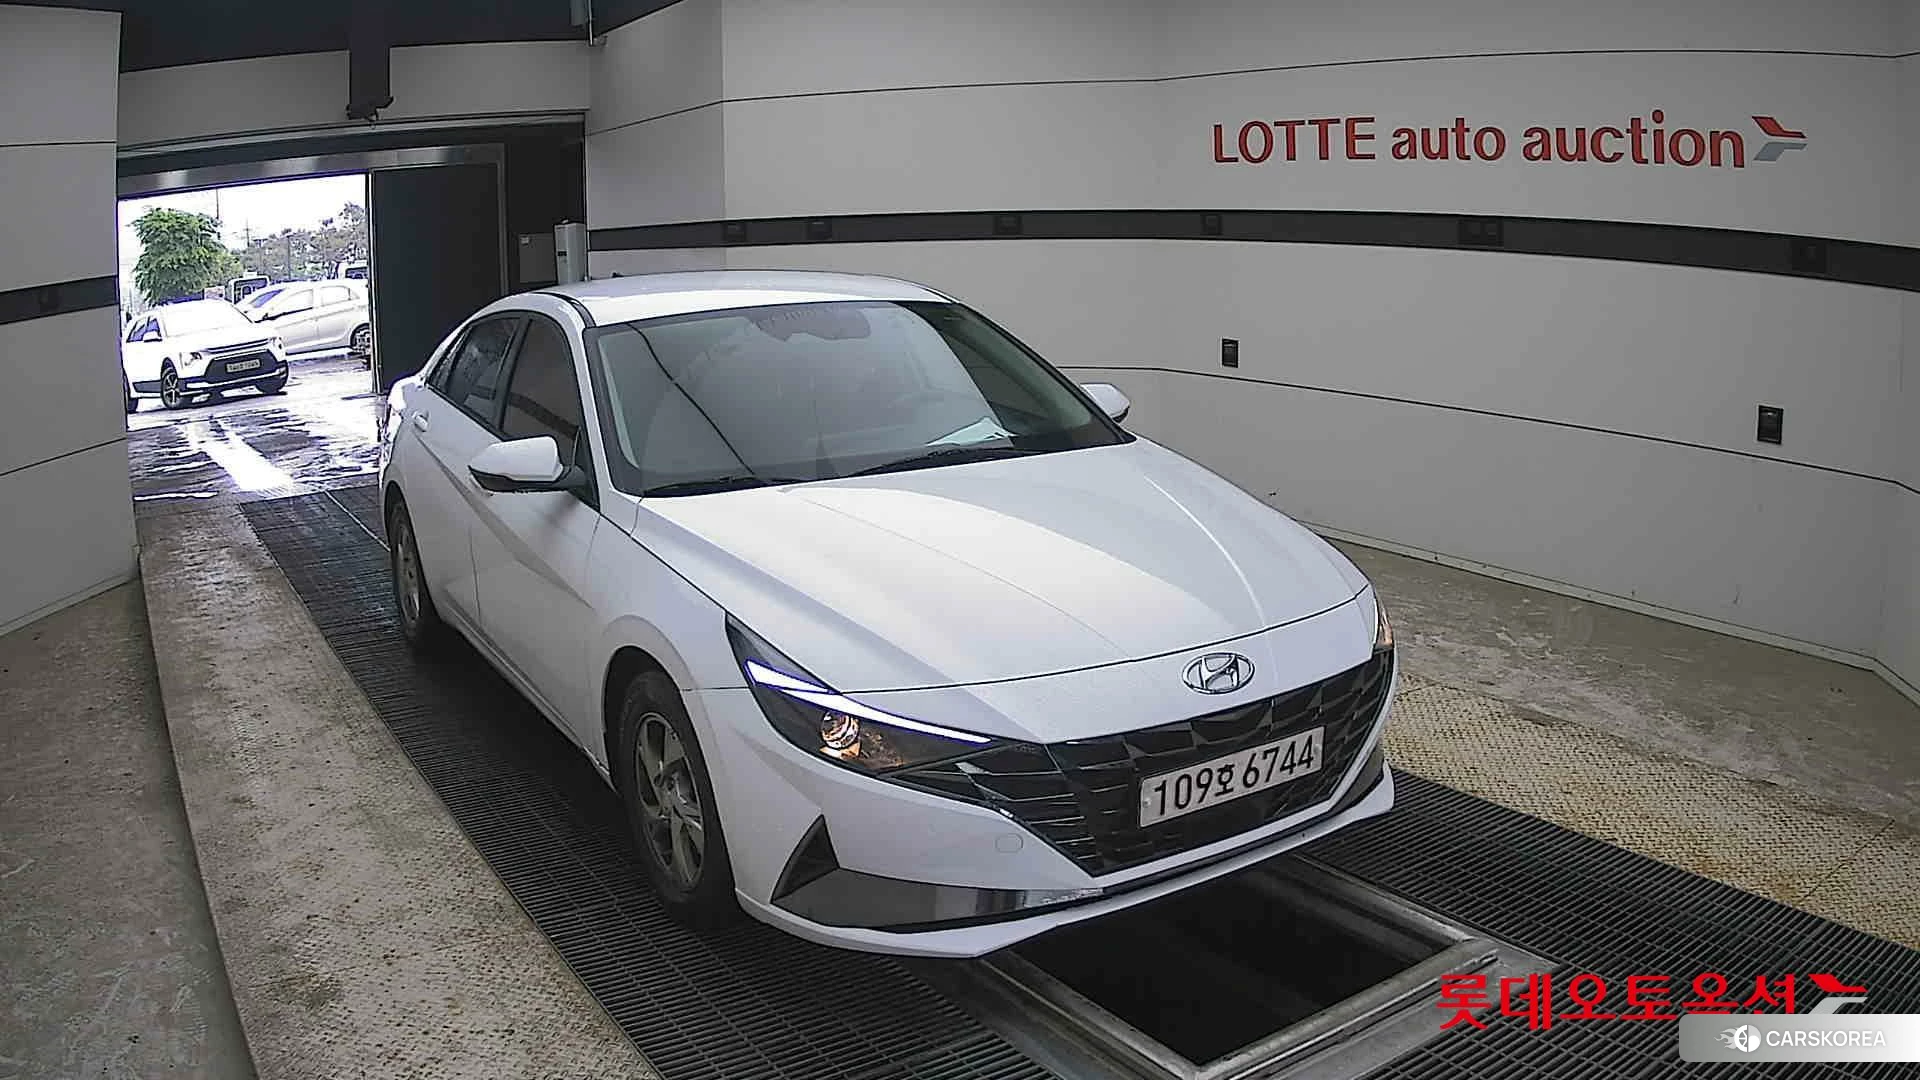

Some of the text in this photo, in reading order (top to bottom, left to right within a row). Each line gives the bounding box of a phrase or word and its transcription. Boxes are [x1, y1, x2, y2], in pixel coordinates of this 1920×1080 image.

[1213, 109, 1745, 168] LOTTE auto auction
[1242, 734, 1314, 789] 6744
